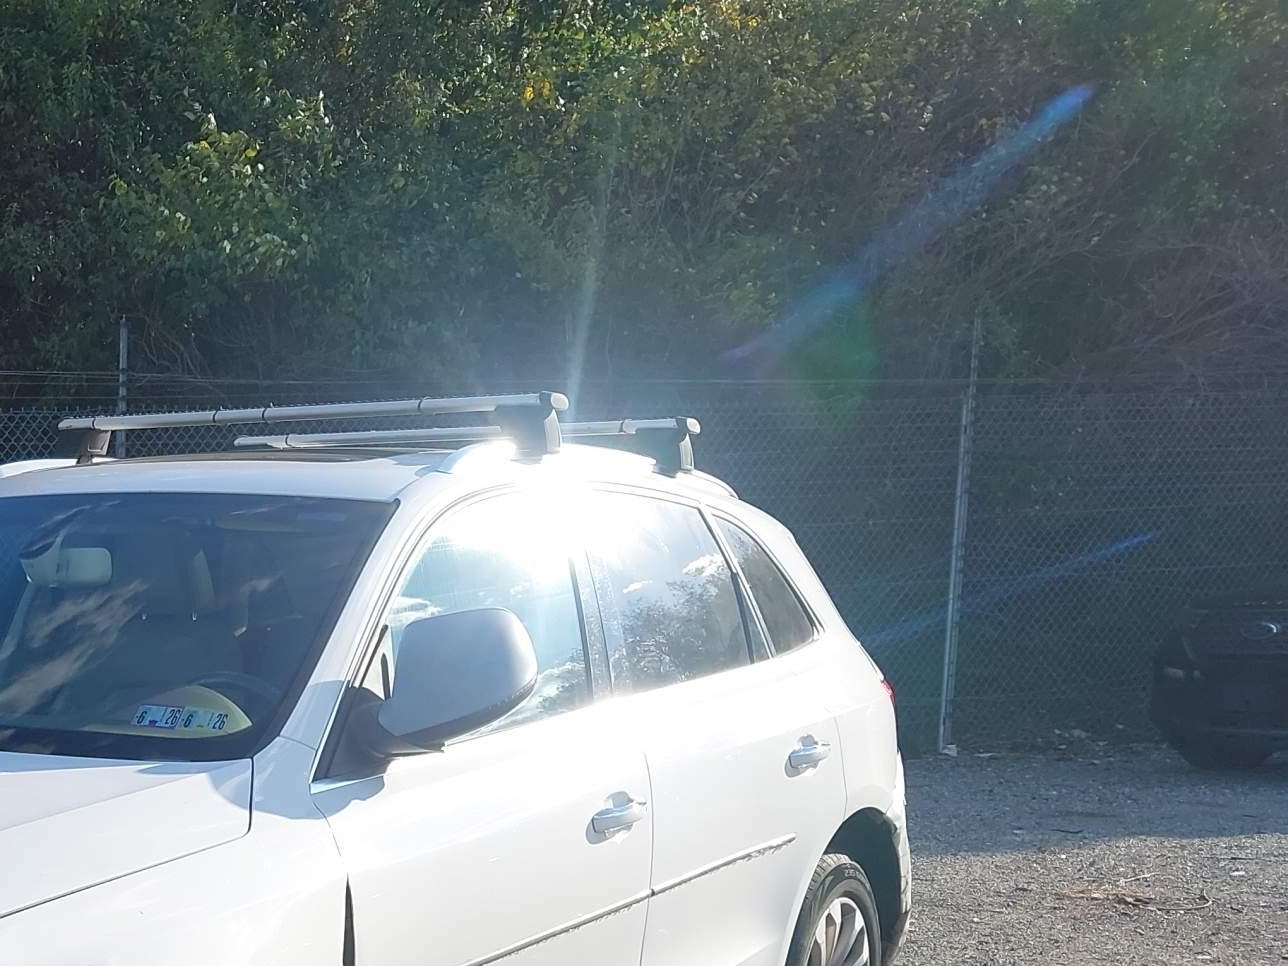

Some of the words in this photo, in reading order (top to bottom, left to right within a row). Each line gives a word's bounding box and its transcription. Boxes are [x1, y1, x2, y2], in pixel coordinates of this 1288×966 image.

[164, 709, 181, 725] 26
[183, 714, 194, 728] 6
[212, 713, 229, 730] 26
